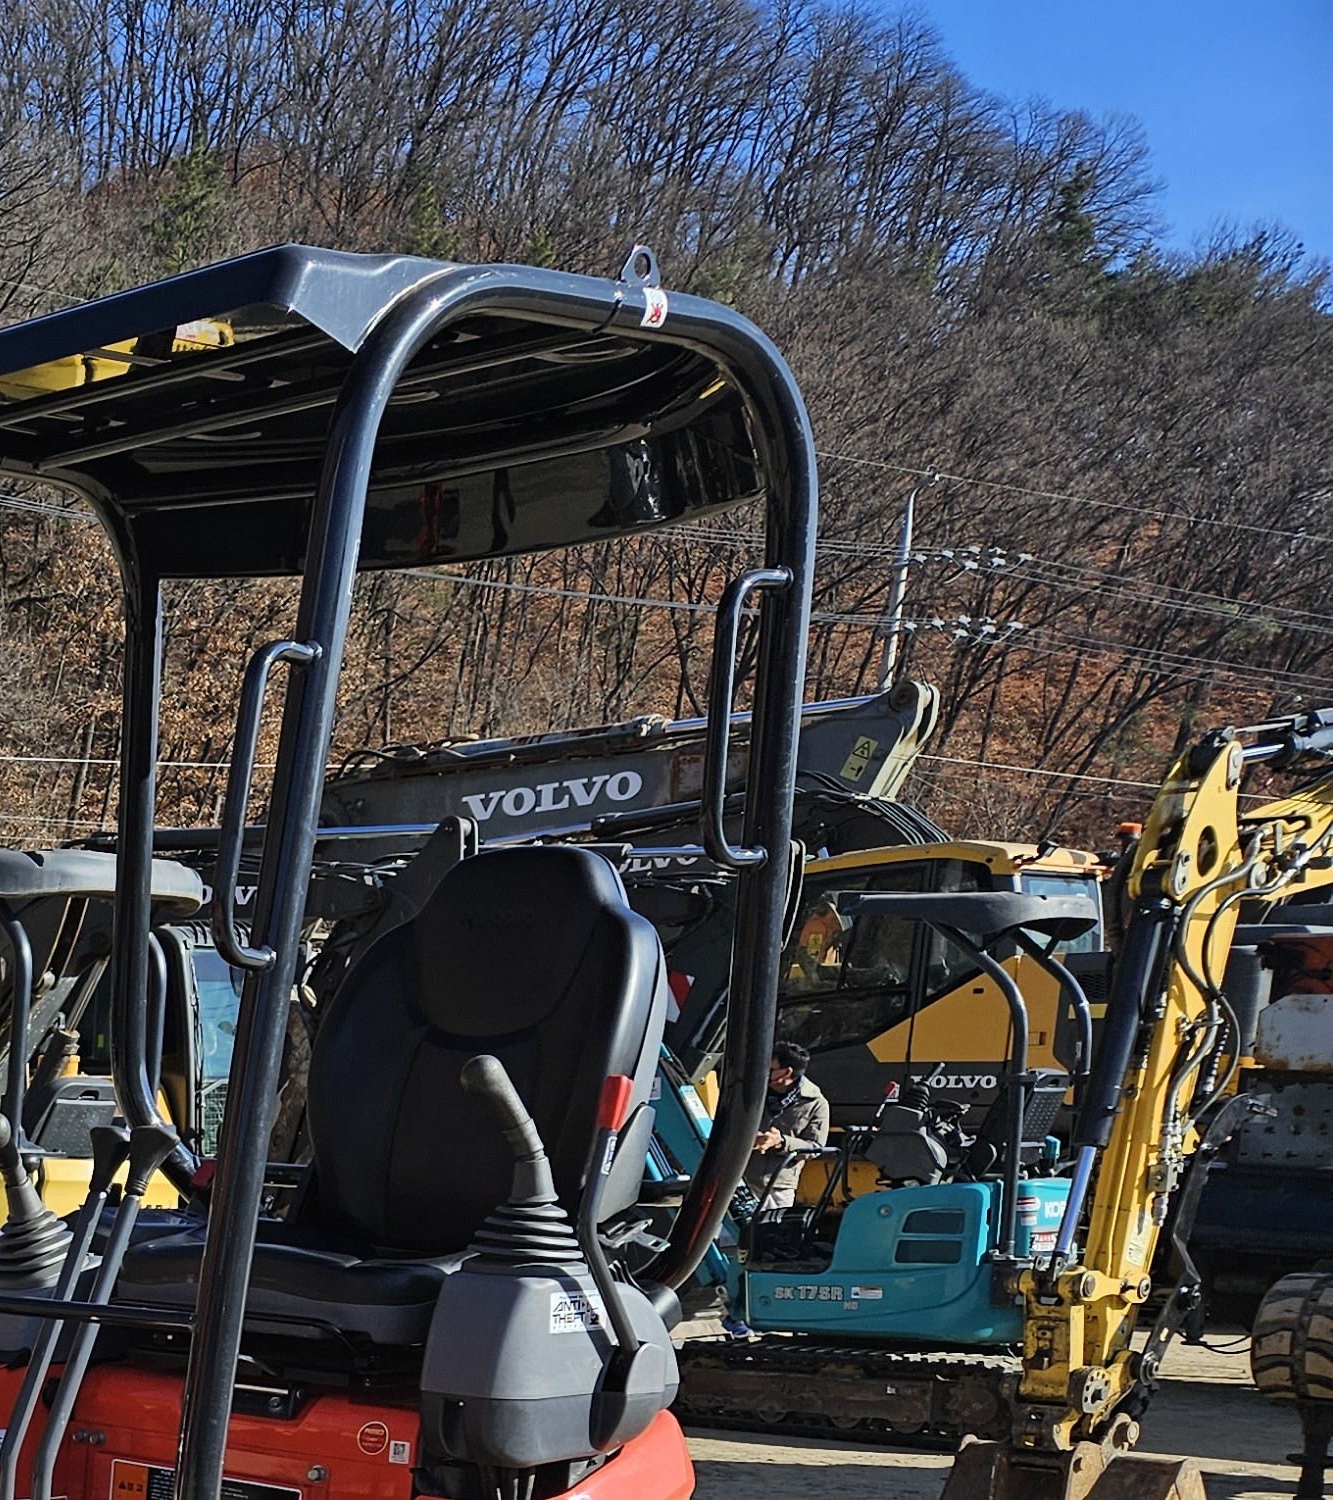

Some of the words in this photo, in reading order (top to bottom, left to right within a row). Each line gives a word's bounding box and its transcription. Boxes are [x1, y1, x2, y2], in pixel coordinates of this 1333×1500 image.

[462, 771, 642, 821] VOLVO
[774, 1287, 794, 1299] SK
[798, 1285, 844, 1301] 17SR
